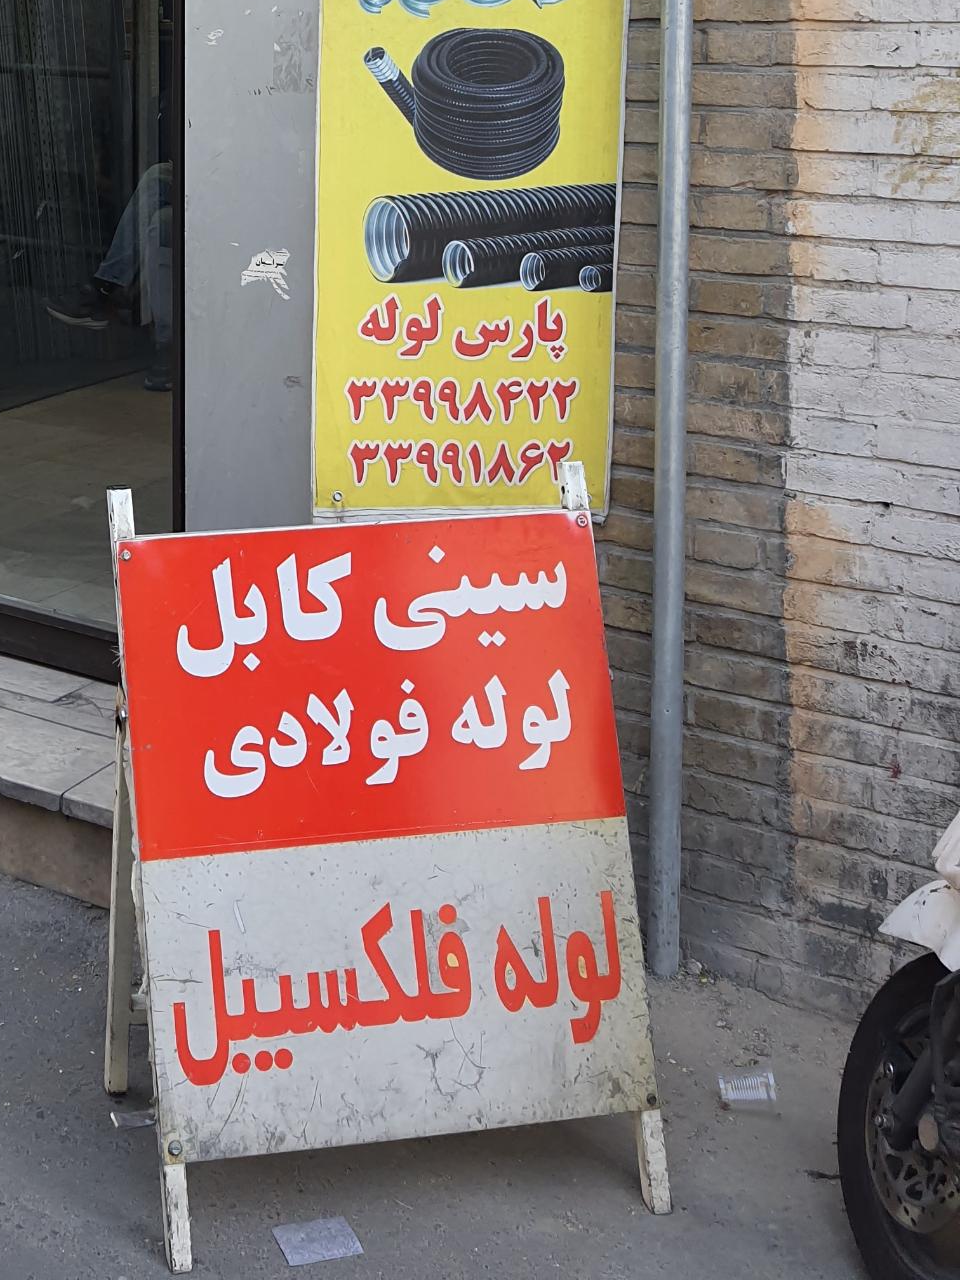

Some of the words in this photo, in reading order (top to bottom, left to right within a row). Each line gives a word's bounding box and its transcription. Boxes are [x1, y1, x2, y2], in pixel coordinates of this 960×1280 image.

[358, 293, 444, 359] لوله
[452, 296, 566, 361] پارس
[344, 377, 579, 424] ۳۳۹۹۸۴۲۲
[348, 438, 572, 486] ۳۳۹۹۱۸۶۲
[176, 551, 351, 678] کابل
[374, 545, 568, 651] سینی
[204, 679, 430, 799] فولادی
[451, 669, 572, 770] لوله
[173, 901, 472, 1088] فلکسیبل
[494, 890, 622, 1045] لوله
